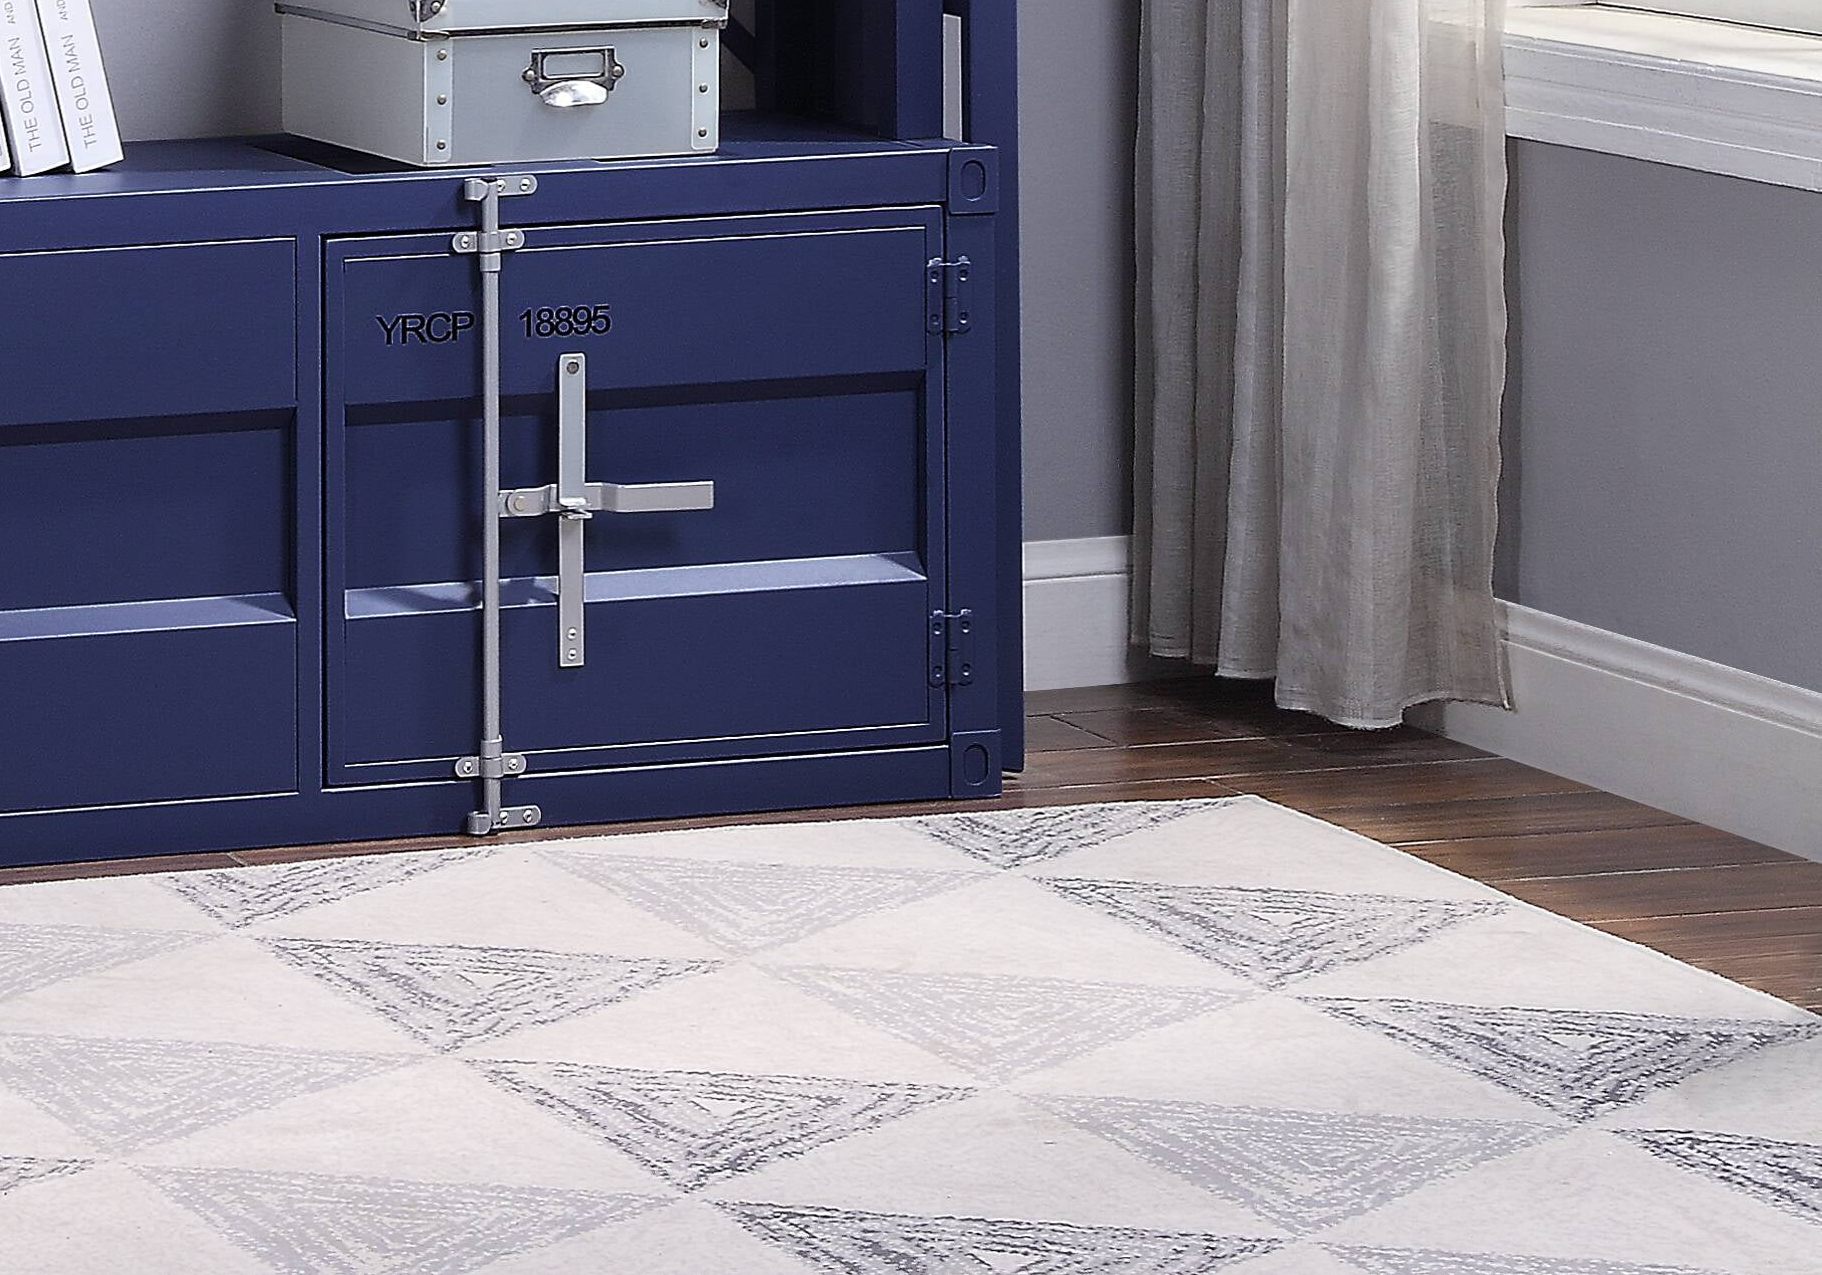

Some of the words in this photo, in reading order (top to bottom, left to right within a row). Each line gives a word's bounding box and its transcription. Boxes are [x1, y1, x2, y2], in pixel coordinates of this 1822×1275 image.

[4, 0, 17, 24] AND
[7, 37, 27, 76] MAN
[60, 34, 81, 73] MAN
[16, 78, 35, 114] OLD
[70, 75, 89, 111] OLD
[24, 117, 42, 153] THE
[79, 113, 98, 149] THE
[375, 311, 476, 346] YRCP
[518, 304, 612, 338] 18895
